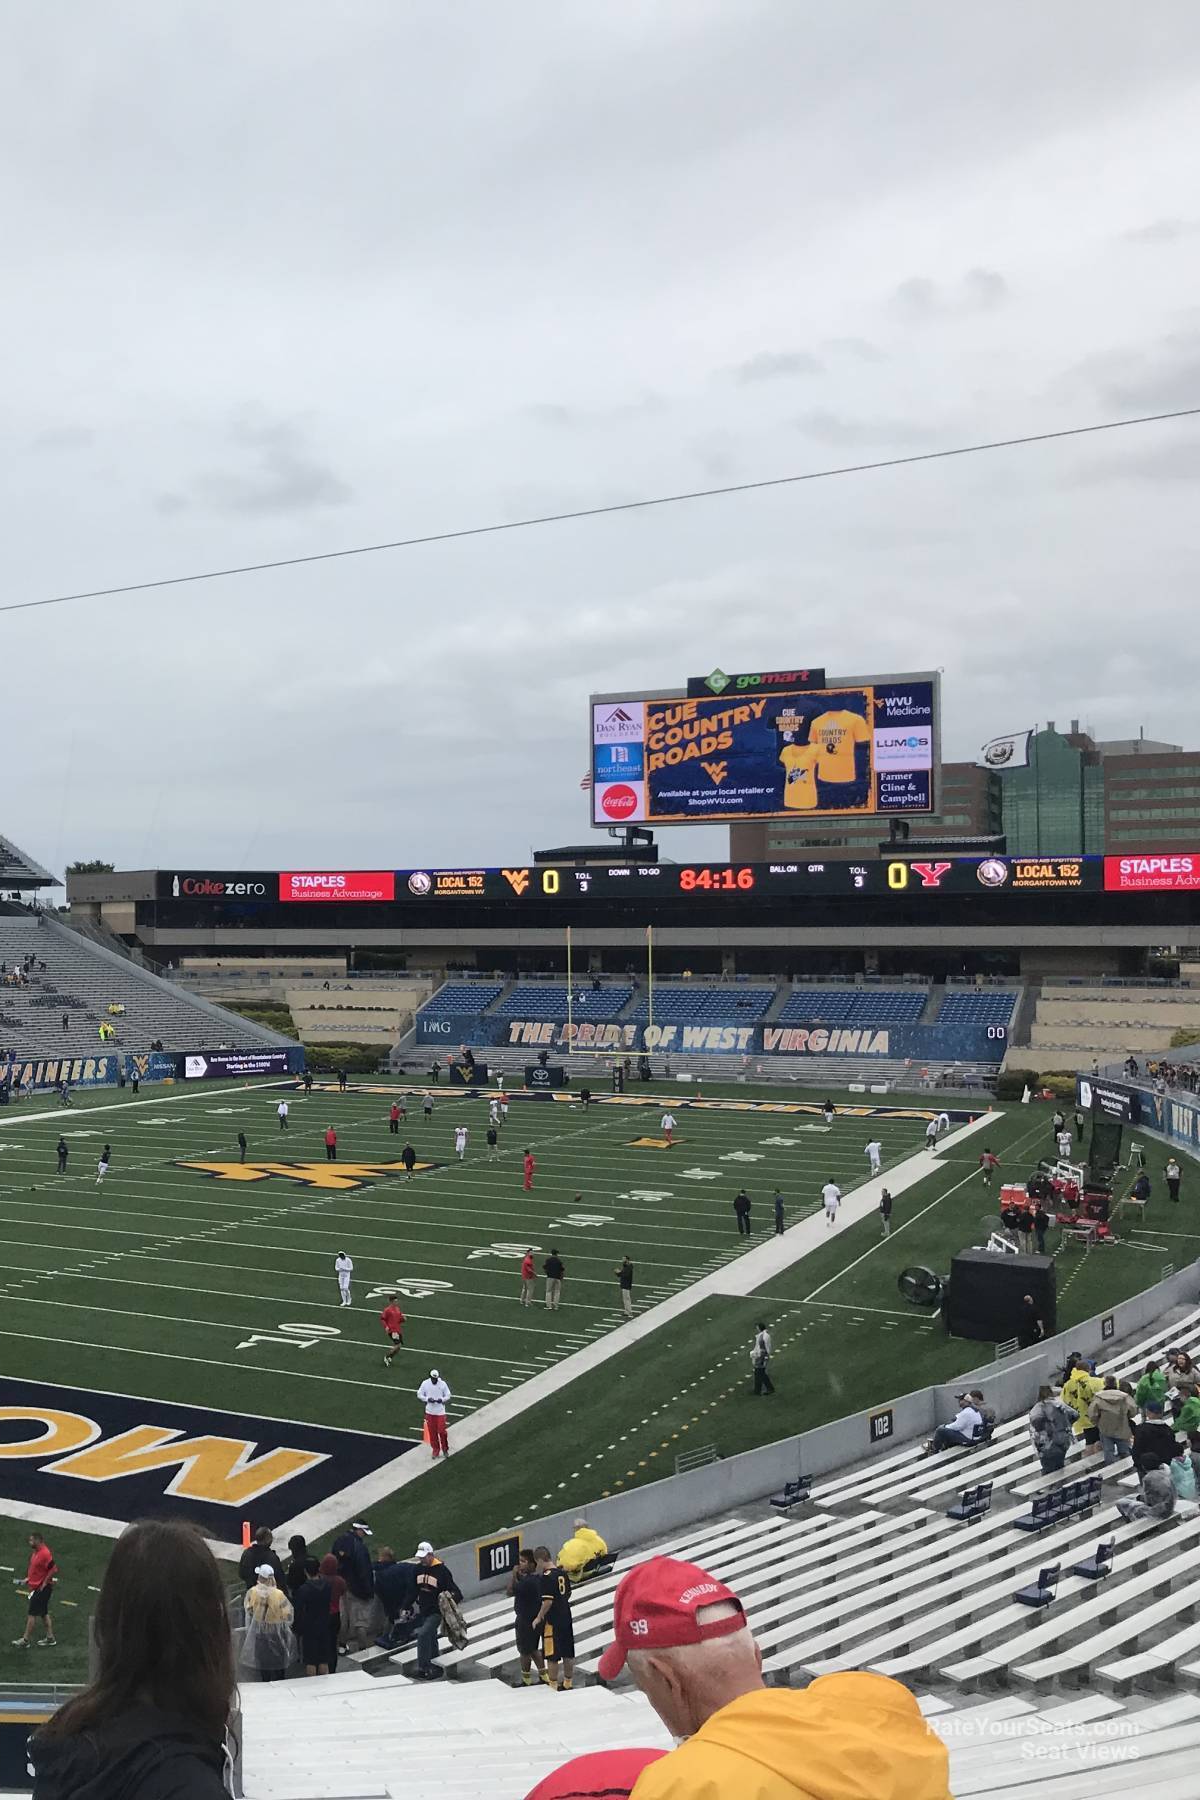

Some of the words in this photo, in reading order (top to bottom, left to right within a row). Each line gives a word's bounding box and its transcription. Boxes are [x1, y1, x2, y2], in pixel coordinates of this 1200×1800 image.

[736, 670, 810, 688] gomart
[885, 697, 912, 707] WVU
[650, 702, 697, 730] CUE
[887, 706, 930, 716] Medicine
[596, 723, 615, 733] DAN
[618, 722, 642, 732] RYAN
[650, 699, 767, 750] COUNTRY
[650, 731, 733, 771] ROADS
[597, 764, 642, 774] northeast
[880, 772, 912, 781] Farmer
[658, 789, 691, 798] Available
[692, 789, 700, 797] at
[700, 789, 718, 799] your
[718, 788, 737, 796] local
[738, 786, 765, 795] retailer
[880, 783, 905, 792] Cline
[907, 782, 917, 791] &
[688, 797, 743, 806] ShopWVU.com
[880, 793, 926, 804] Campbell
[769, 865, 786, 873] BALL
[807, 864, 824, 872] QTR
[1016, 865, 1056, 878] LOCAL
[1057, 864, 1079, 877] 152
[1120, 857, 1193, 874] STAPLES
[608, 868, 630, 876] DOWN
[638, 868, 648, 876] TO
[648, 868, 660, 876] GO
[888, 862, 907, 889] 0
[290, 875, 346, 888] STAPLES
[437, 877, 466, 888] LOCAL
[467, 876, 483, 887] 152
[542, 869, 560, 894] 0
[680, 868, 754, 890] 84:16
[854, 876, 863, 888] 3
[1012, 879, 1068, 887] MORGANTOWN
[1120, 876, 1172, 887] Business
[579, 881, 588, 892] 3
[291, 888, 331, 898] Business
[332, 888, 383, 899] Advantage
[423, 1021, 451, 1034] IMG
[987, 1027, 1005, 1039] 00
[509, 1022, 555, 1043] THE
[560, 1023, 637, 1046] PRIDE
[644, 1026, 678, 1048] OF
[682, 1026, 754, 1050] WEST
[763, 1028, 889, 1053] VIRGINIA
[370, 1278, 455, 1299] 20
[246, 1322, 342, 1349] 10
[874, 1415, 890, 1437] 102
[489, 1544, 510, 1571] 101
[557, 1575, 566, 1596] 8
[629, 1618, 649, 1637] 99
